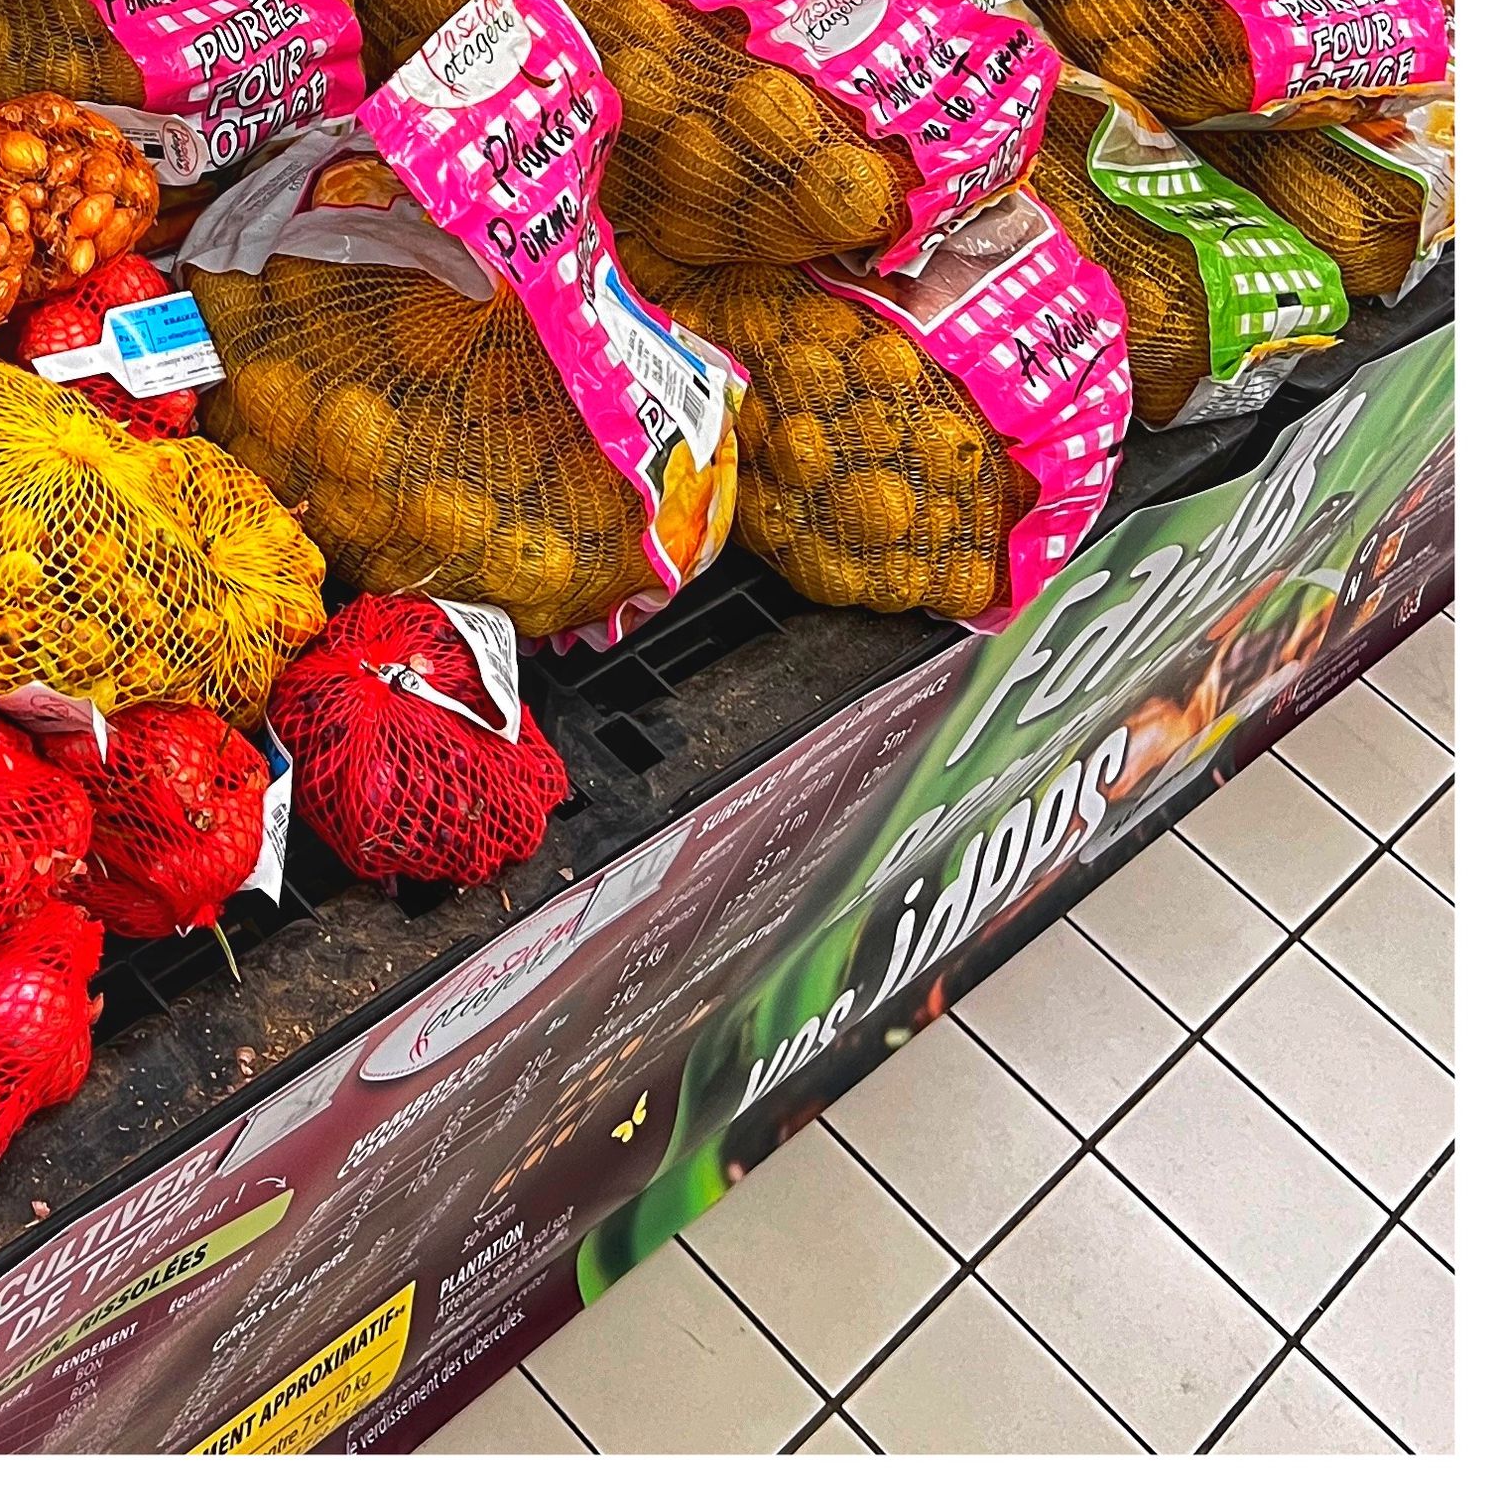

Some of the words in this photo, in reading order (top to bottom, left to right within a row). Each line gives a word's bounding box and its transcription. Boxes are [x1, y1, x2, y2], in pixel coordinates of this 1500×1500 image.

[856, 51, 929, 121] Plants
[928, 26, 957, 66] de
[482, 105, 574, 199] Plants
[574, 82, 597, 131] de
[942, 89, 976, 130] de
[488, 186, 582, 281] Pomme
[1018, 336, 1053, 387] A
[884, 671, 953, 724] SURFACE
[696, 769, 783, 840] SURFACE
[617, 980, 645, 1007] kg
[6, 1286, 77, 1352] DE
[85, 1177, 210, 1287] TERRE
[142, 1197, 228, 1265] couleur
[438, 1221, 525, 1299] PLANTATION
[78, 1242, 209, 1333] RISSOLÉES
[212, 1302, 268, 1352] GROS
[270, 1243, 355, 1312] CALIBRE
[51, 1320, 140, 1379] RENDEMENT
[74, 1355, 104, 1382] BON
[299, 1412, 315, 1435] 7
[314, 1404, 331, 1427] et
[333, 1384, 353, 1410] 10
[353, 1370, 374, 1397] kg
[359, 1375, 442, 1448] verdissement
[440, 1357, 463, 1384] des
